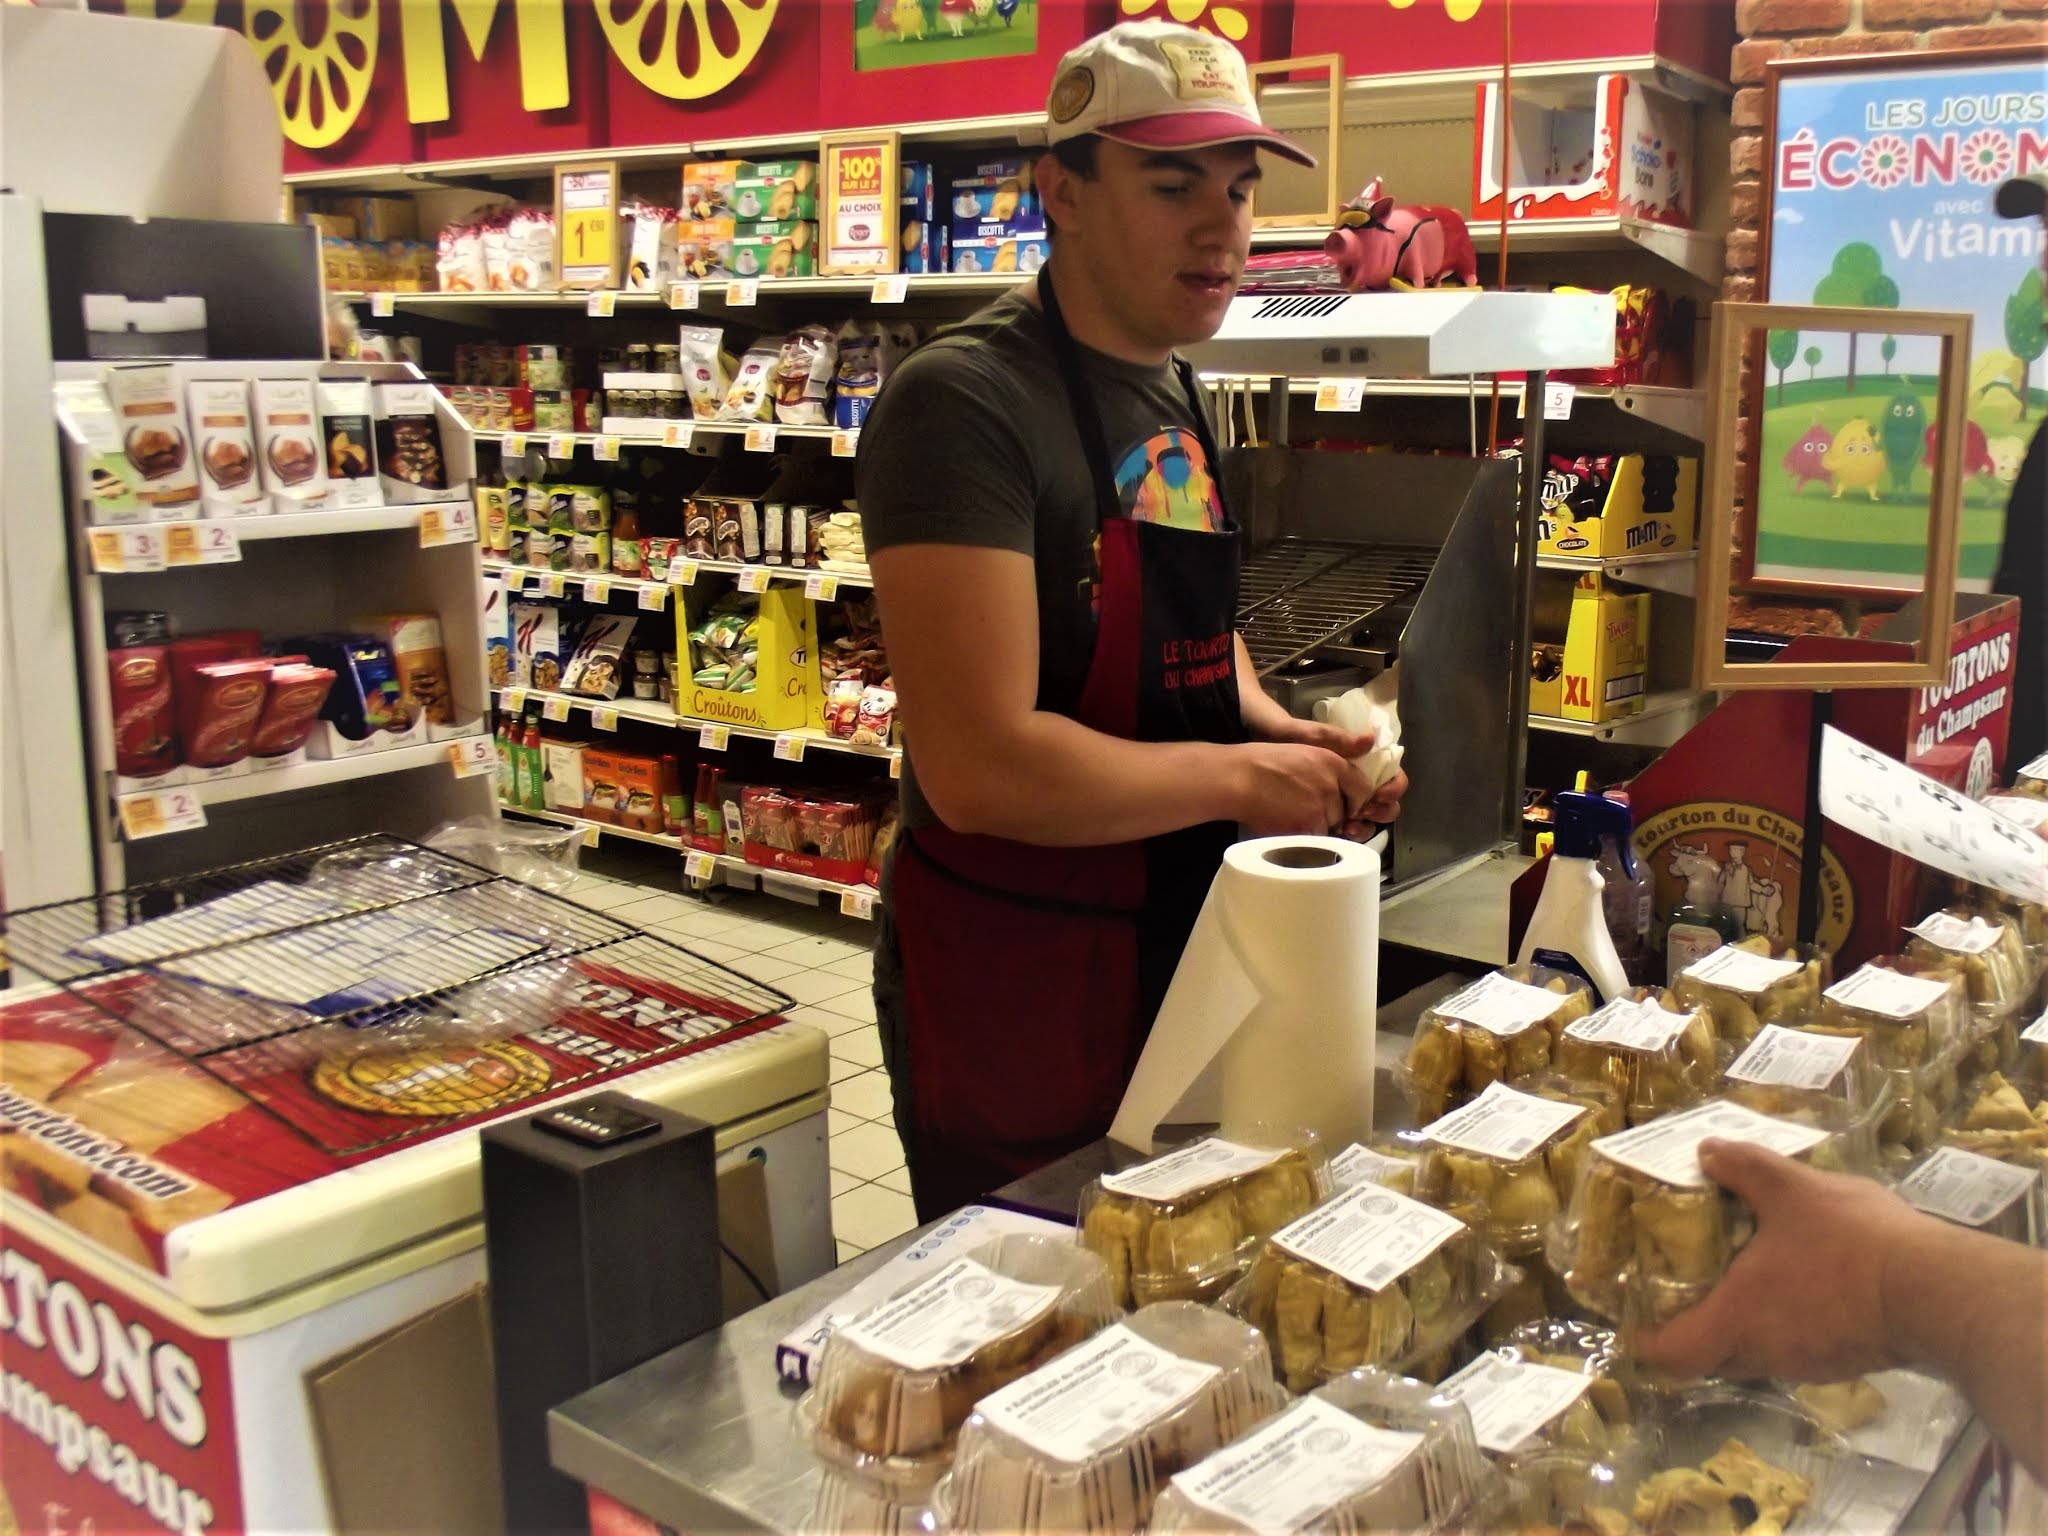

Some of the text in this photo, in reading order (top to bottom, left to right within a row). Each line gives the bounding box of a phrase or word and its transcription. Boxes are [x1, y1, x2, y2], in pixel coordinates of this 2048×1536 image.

[1867, 94, 2046, 128] LES JOURS
[841, 180, 859, 191] SUR
[860, 179, 870, 190] LE
[839, 202, 883, 213] AU CHOIX
[1933, 199, 1985, 214] avec
[978, 224, 1005, 237] BISCOTTE
[1554, 392, 1564, 406] 5
[1557, 537, 1588, 549] CHOCOLATE
[1162, 639, 1181, 665] LE
[1563, 674, 1591, 708] XL
[693, 689, 758, 723] Croûtons
[1915, 686, 2007, 758] du Champsaur
[1722, 807, 1751, 825] du
[0, 1248, 208, 1447] TONS
